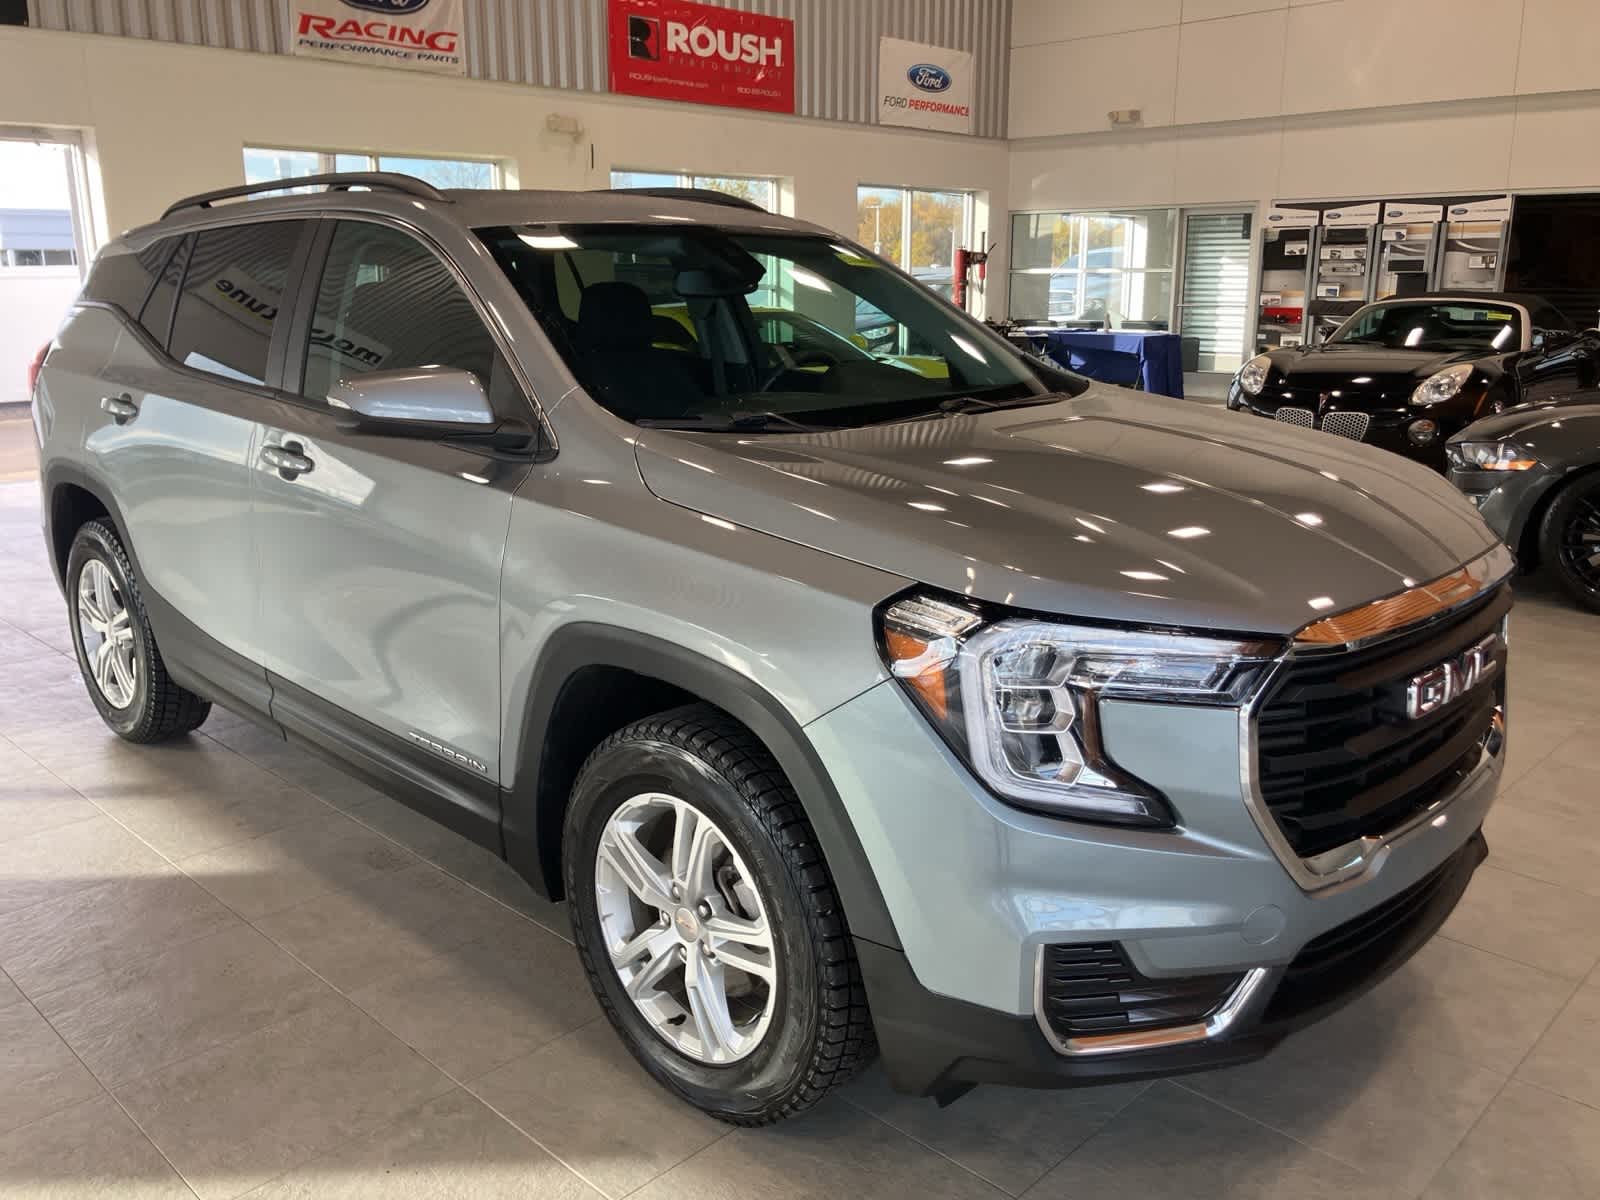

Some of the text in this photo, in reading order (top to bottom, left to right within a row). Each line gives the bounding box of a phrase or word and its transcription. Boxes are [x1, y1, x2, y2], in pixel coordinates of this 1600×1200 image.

[298, 14, 458, 52] RACING
[667, 21, 783, 67] ROUSH
[299, 39, 459, 64] PERFORMANCE PARTS
[916, 67, 943, 88] Ford
[884, 96, 907, 108] FORD
[1407, 633, 1497, 719] GMC
